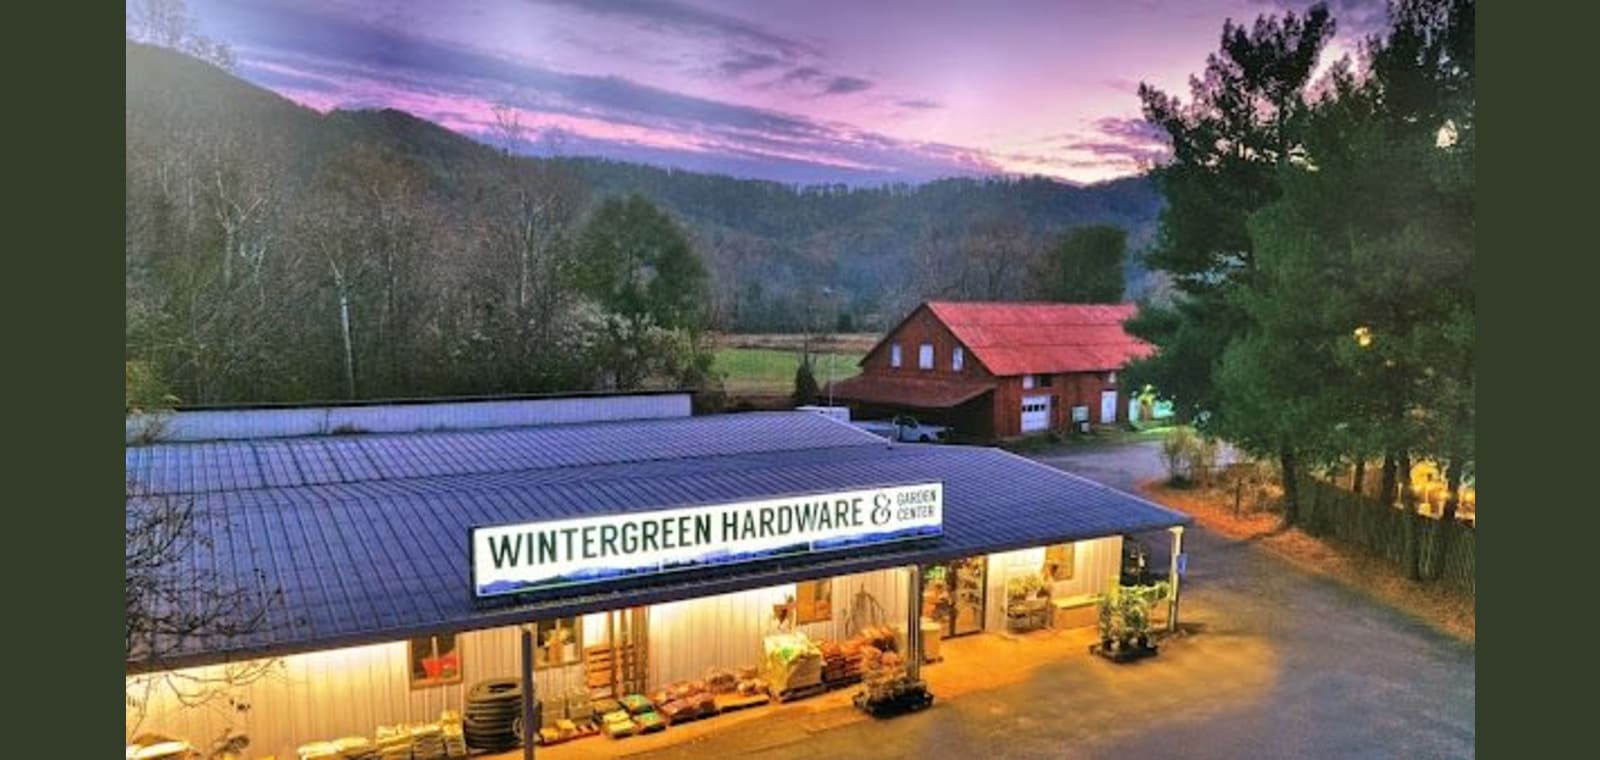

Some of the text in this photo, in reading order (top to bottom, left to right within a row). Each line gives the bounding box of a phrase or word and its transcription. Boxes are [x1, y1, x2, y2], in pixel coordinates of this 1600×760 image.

[896, 489, 937, 505] GARDEN
[896, 506, 935, 521] CENTER
[488, 493, 892, 568] WINTERGREEN HARDWARE &
